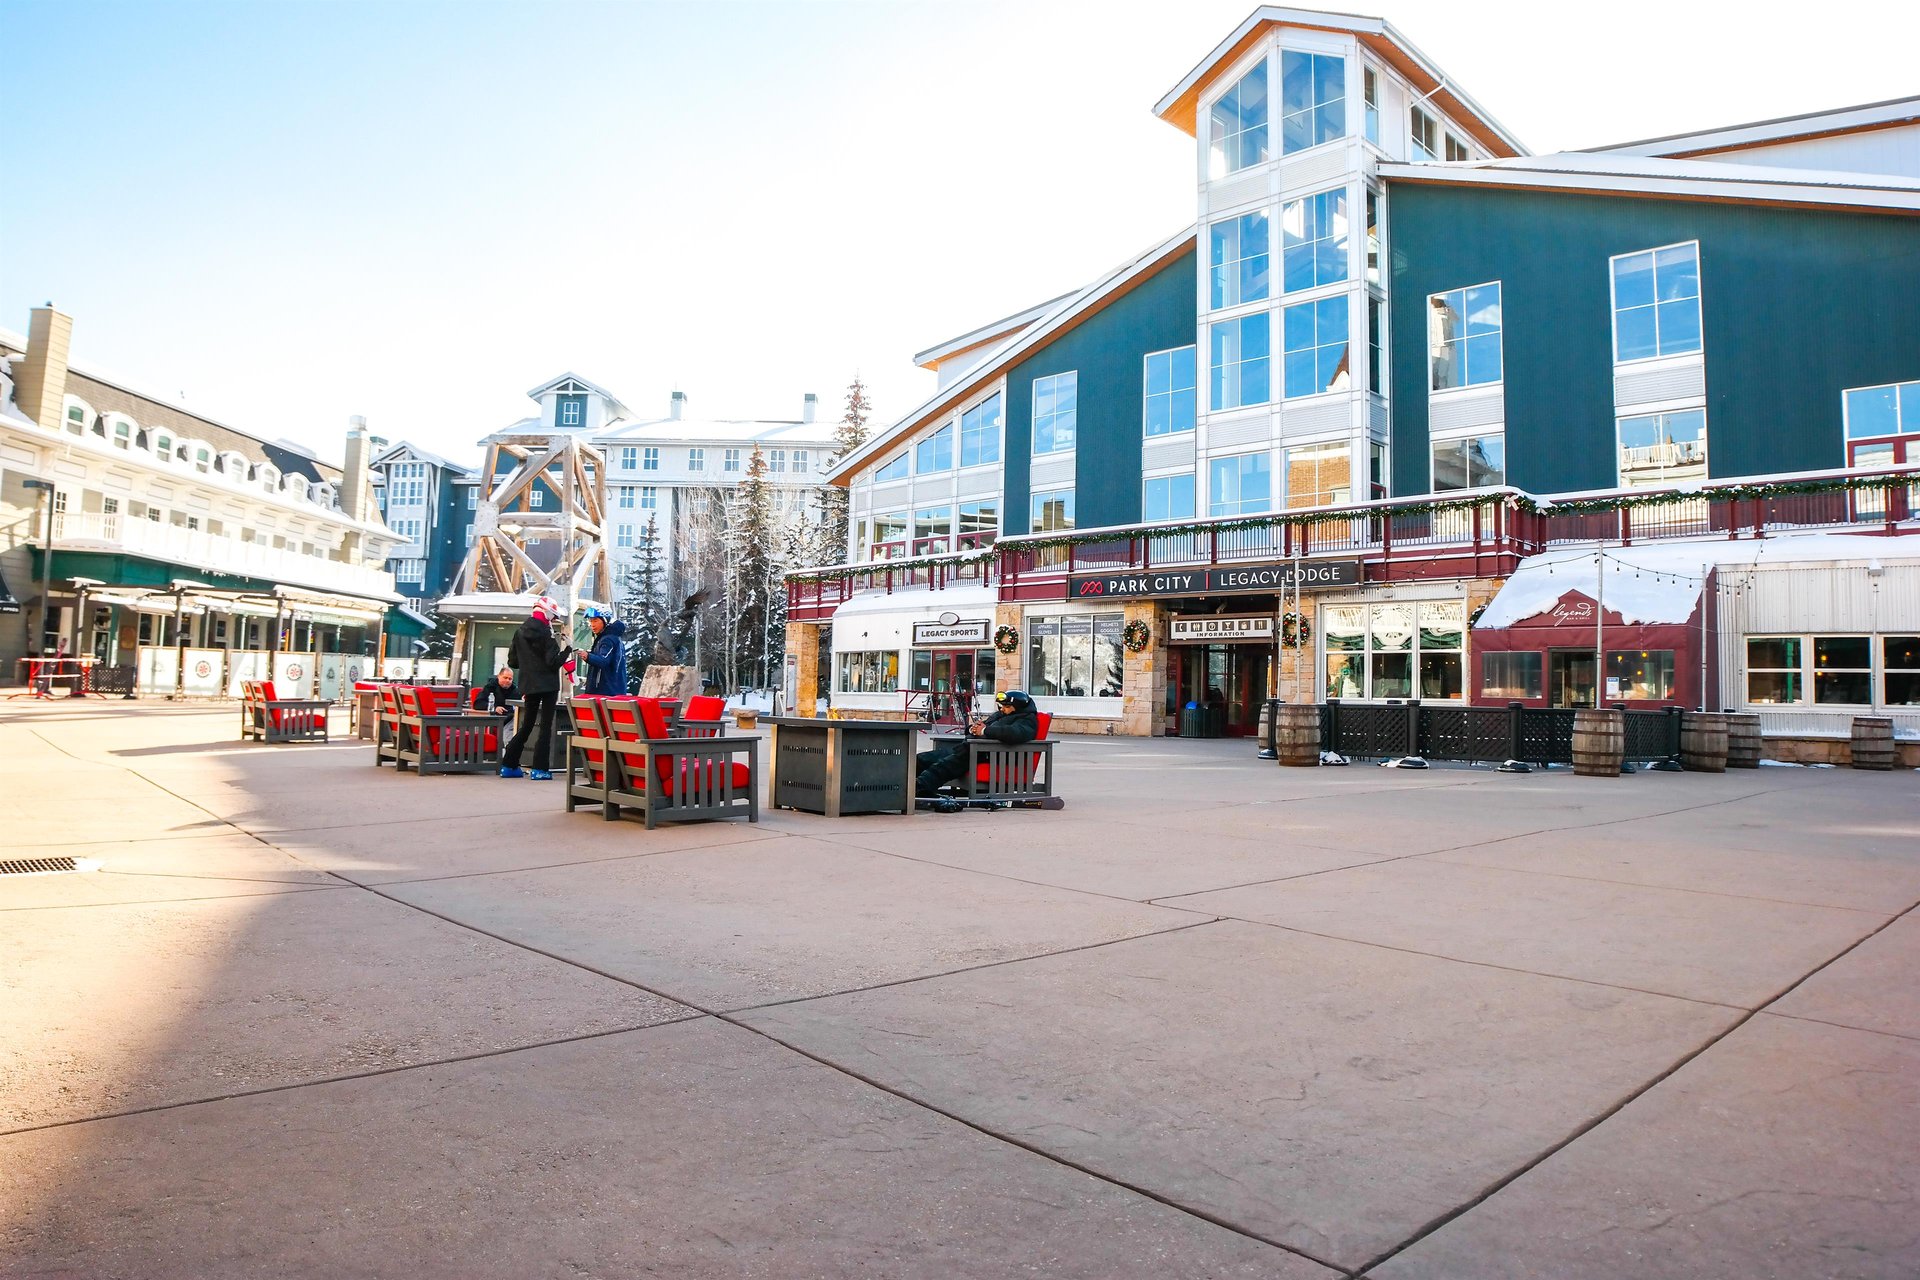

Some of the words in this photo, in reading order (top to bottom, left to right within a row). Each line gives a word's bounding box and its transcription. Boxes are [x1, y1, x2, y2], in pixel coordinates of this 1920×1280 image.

[1109, 579, 1148, 593] PARK
[1154, 575, 1192, 591] CITY
[1220, 570, 1279, 586] LEGACY
[1286, 567, 1340, 582] LODGE
[921, 630, 949, 638] LEGACY
[950, 628, 979, 637] SPORTS
